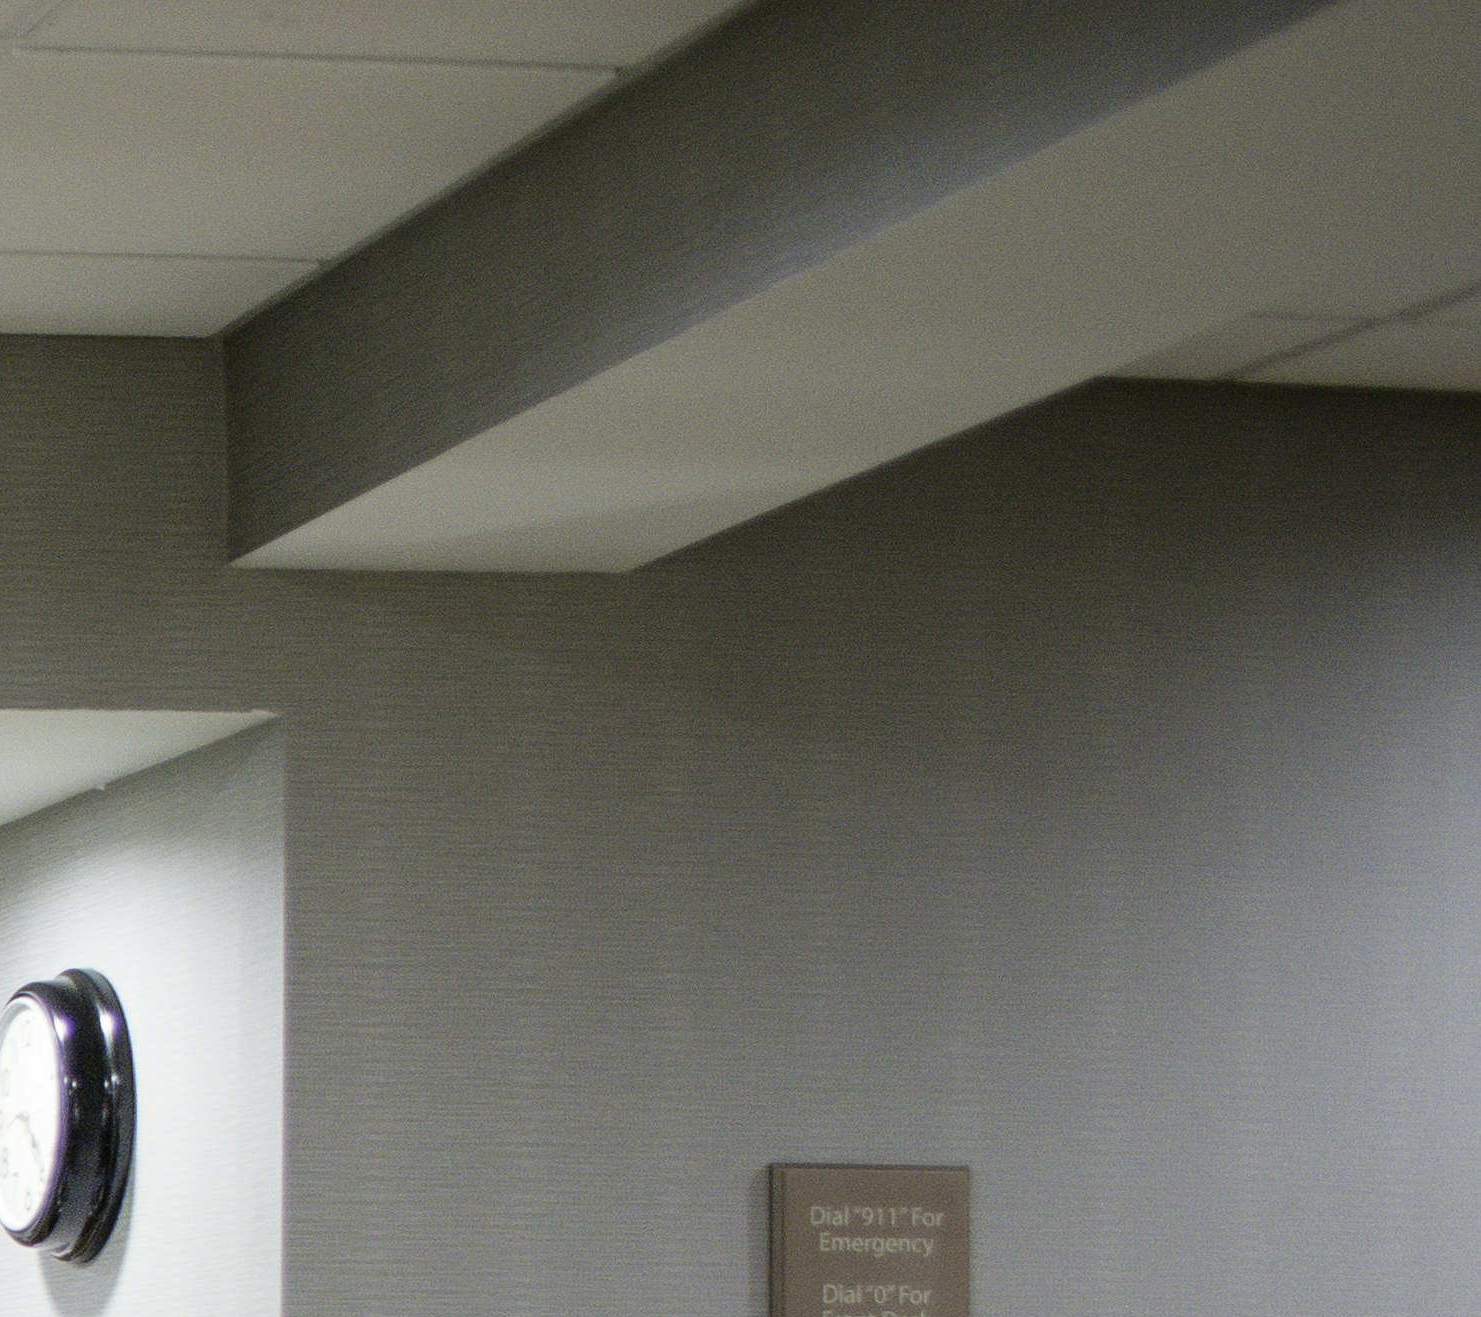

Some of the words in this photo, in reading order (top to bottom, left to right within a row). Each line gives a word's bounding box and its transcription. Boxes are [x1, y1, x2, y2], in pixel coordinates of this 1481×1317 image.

[809, 1206, 849, 1227] Dial
[911, 1207, 945, 1227] For
[819, 1232, 935, 1258] Emergency
[822, 1284, 861, 1304] Dial
[899, 1285, 932, 1305] For
